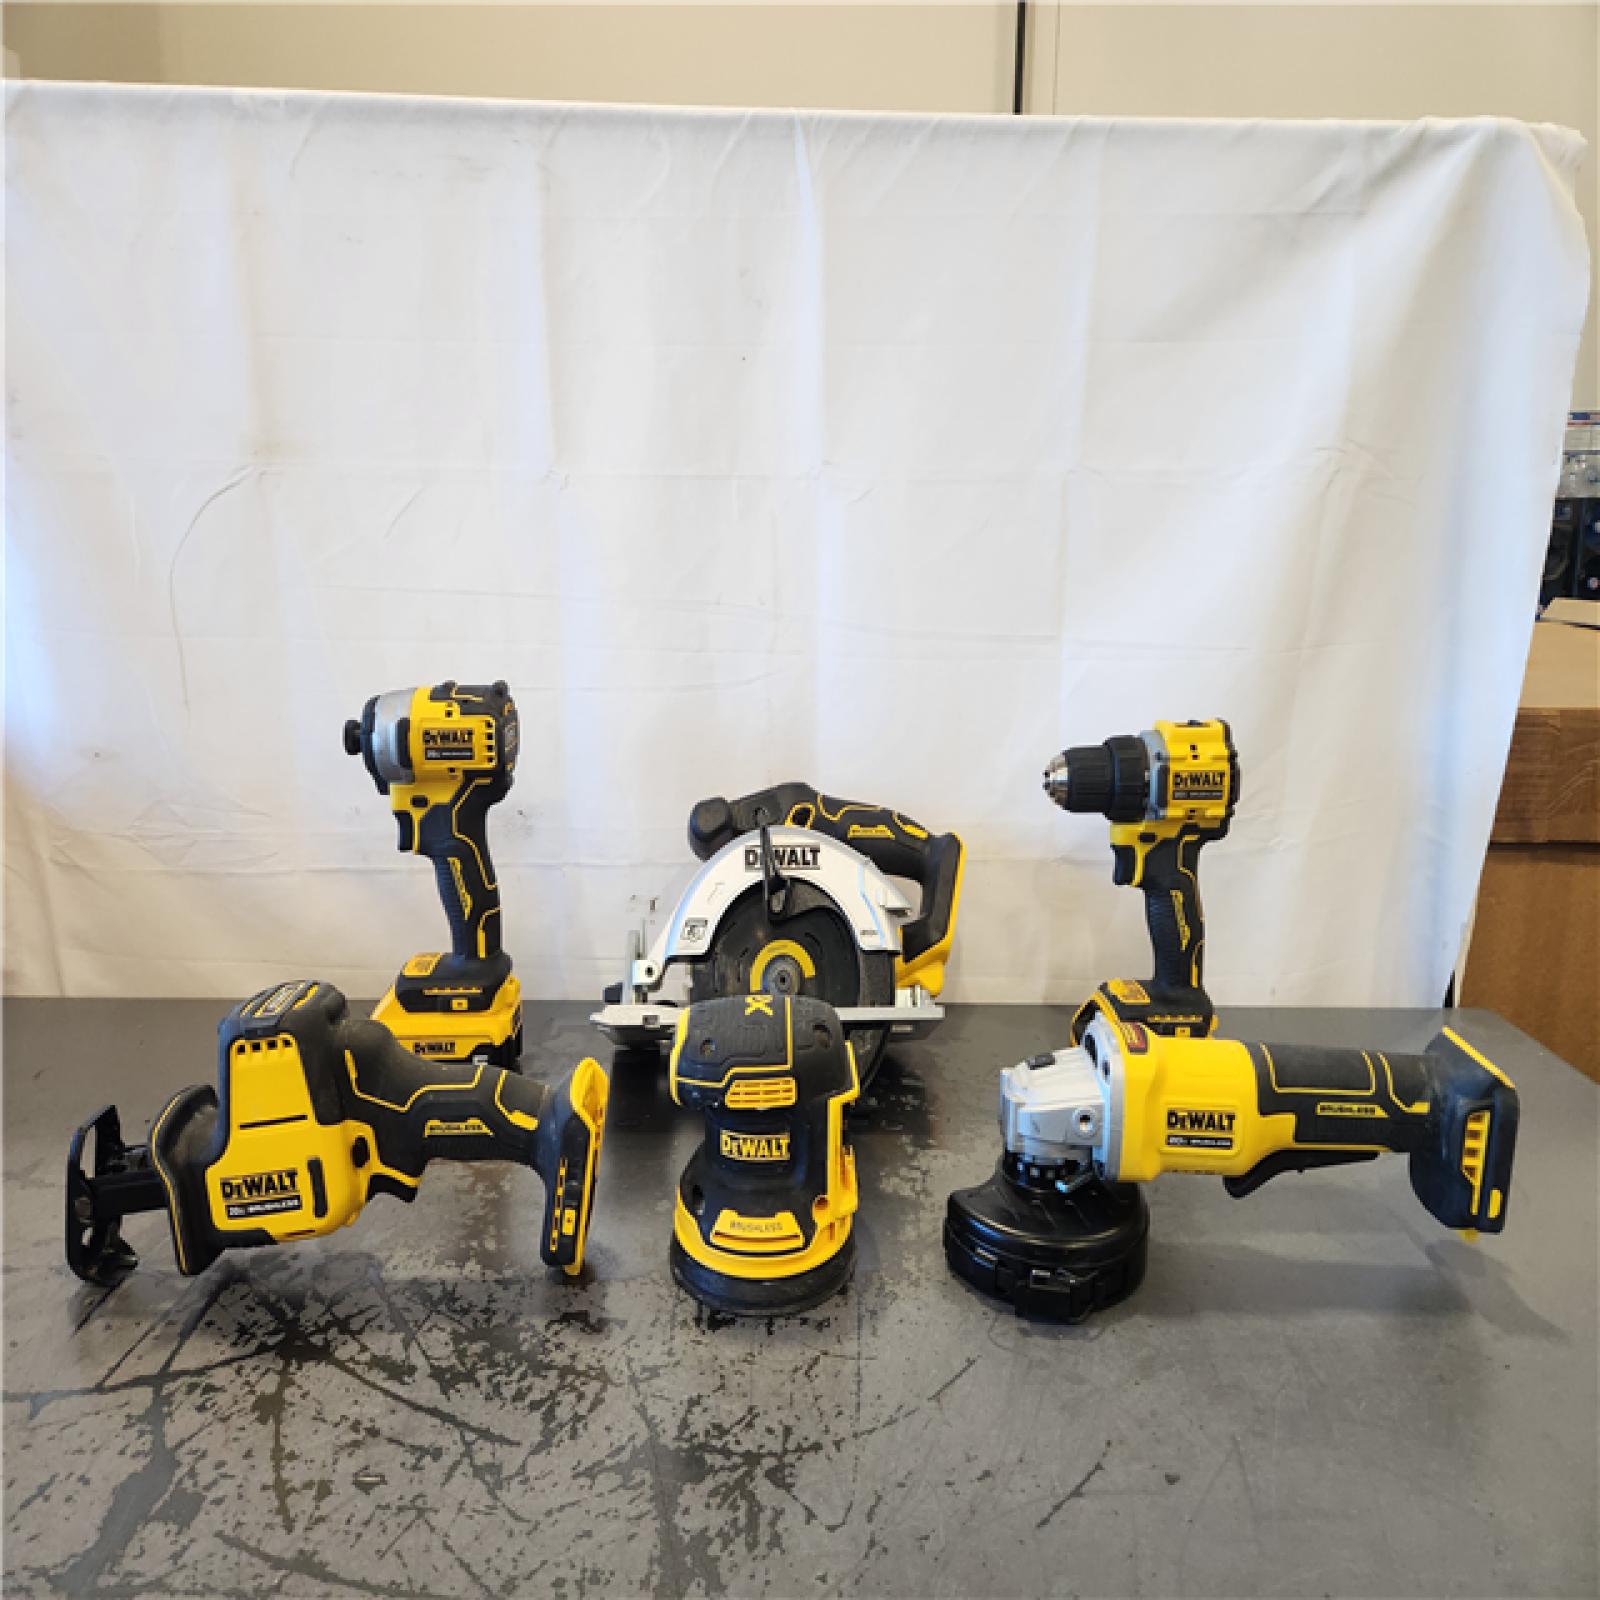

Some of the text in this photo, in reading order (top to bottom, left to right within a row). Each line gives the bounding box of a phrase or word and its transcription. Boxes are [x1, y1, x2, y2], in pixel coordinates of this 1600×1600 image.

[1173, 771, 1225, 787] DEWALT
[745, 848, 820, 868] DWALT
[1167, 1110, 1236, 1132] DEWALT
[720, 1129, 788, 1160] DEWALT
[220, 1168, 299, 1200] DEWALT
